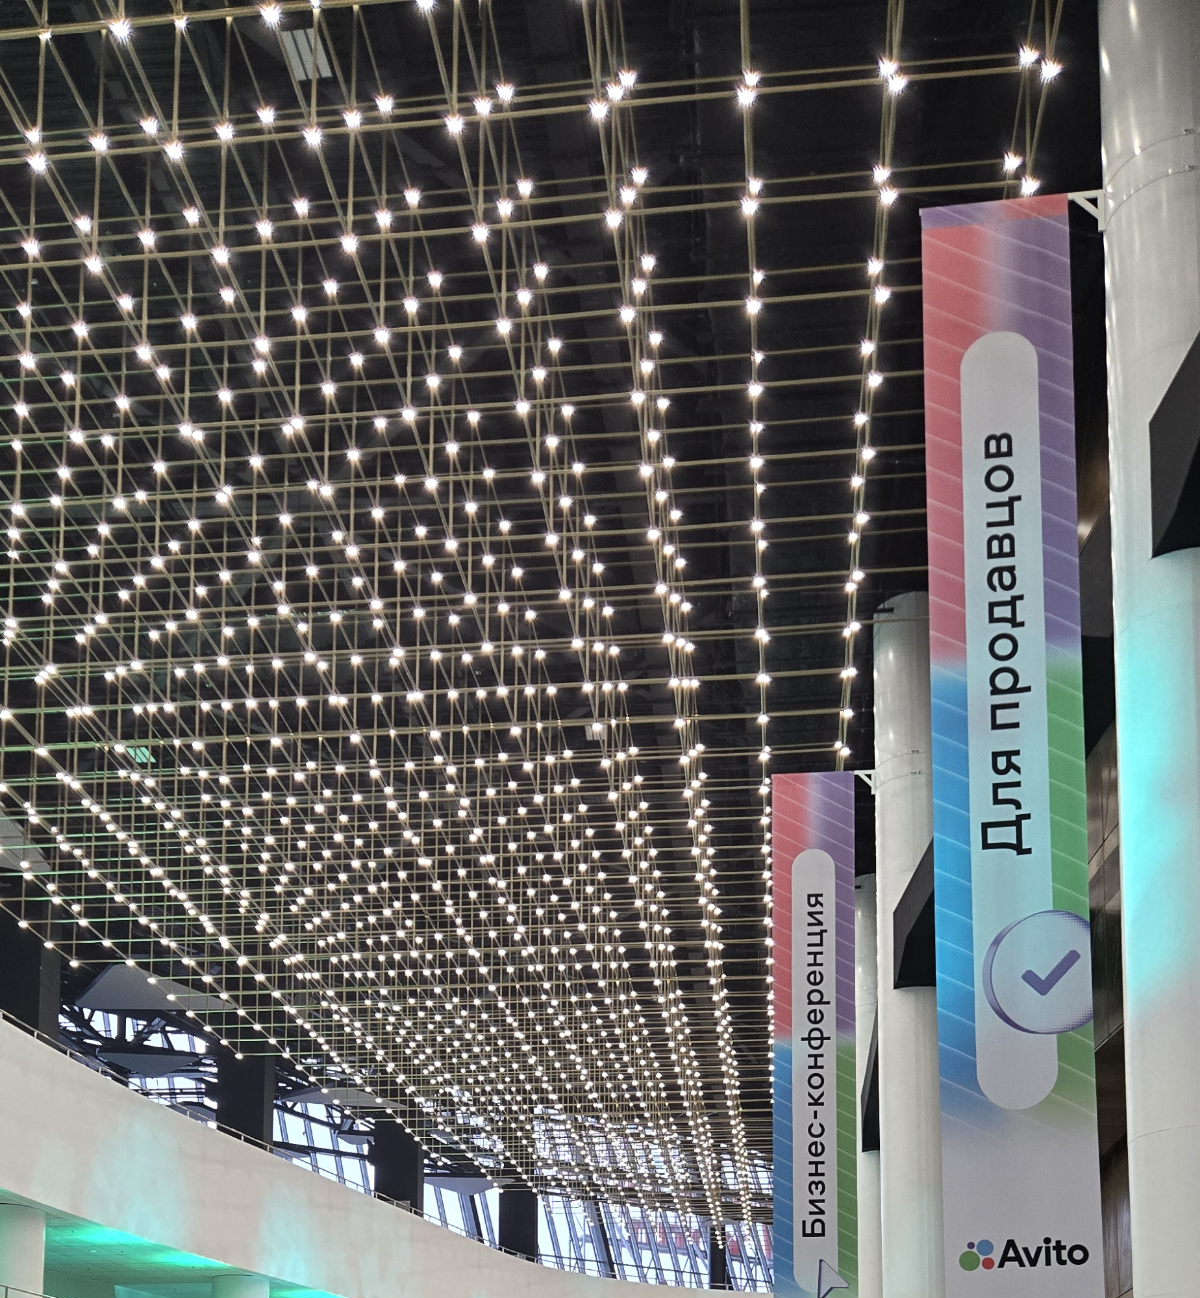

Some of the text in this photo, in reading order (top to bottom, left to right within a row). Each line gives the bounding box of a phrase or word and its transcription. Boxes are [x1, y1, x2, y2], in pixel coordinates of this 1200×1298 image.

[981, 432, 1032, 856] Для продавцов
[800, 893, 831, 1238] Бизнес-конференция
[997, 1236, 1090, 1269] Avito
